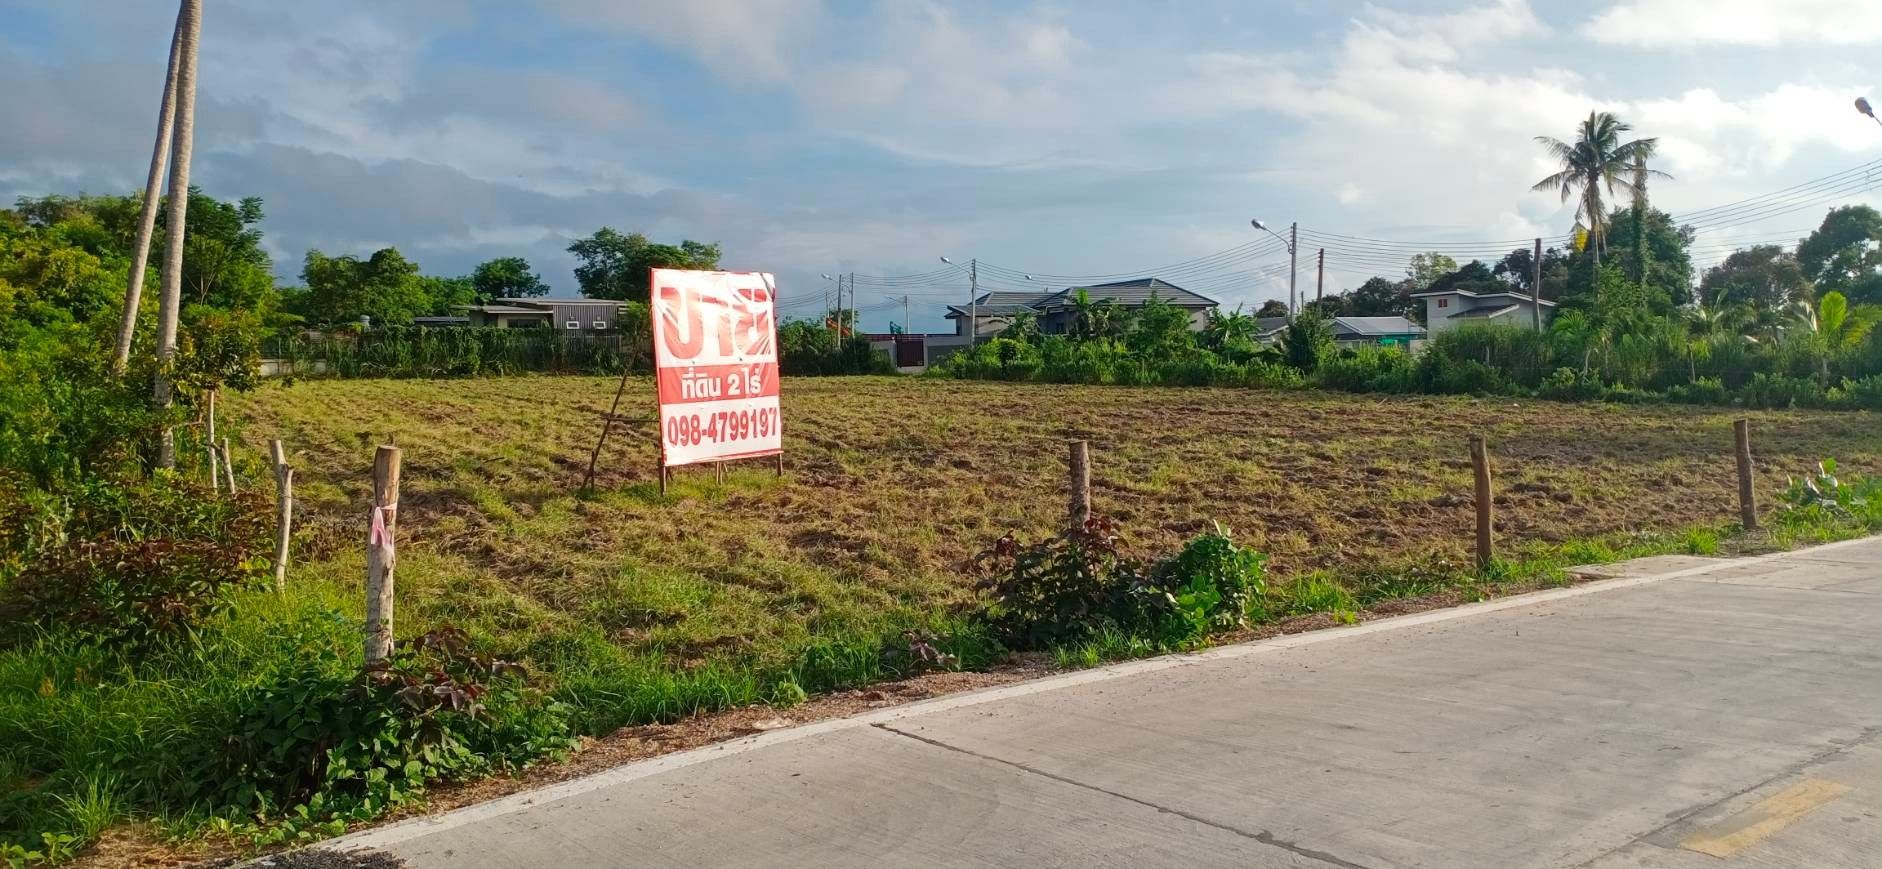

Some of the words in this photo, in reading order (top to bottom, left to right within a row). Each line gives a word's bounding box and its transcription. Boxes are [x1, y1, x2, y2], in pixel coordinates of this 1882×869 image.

[661, 286, 771, 359] ขาย
[681, 367, 721, 399] ที่ดิน
[727, 373, 741, 396] 2
[741, 366, 761, 395] ไร่
[667, 407, 777, 447] 098-4799197
